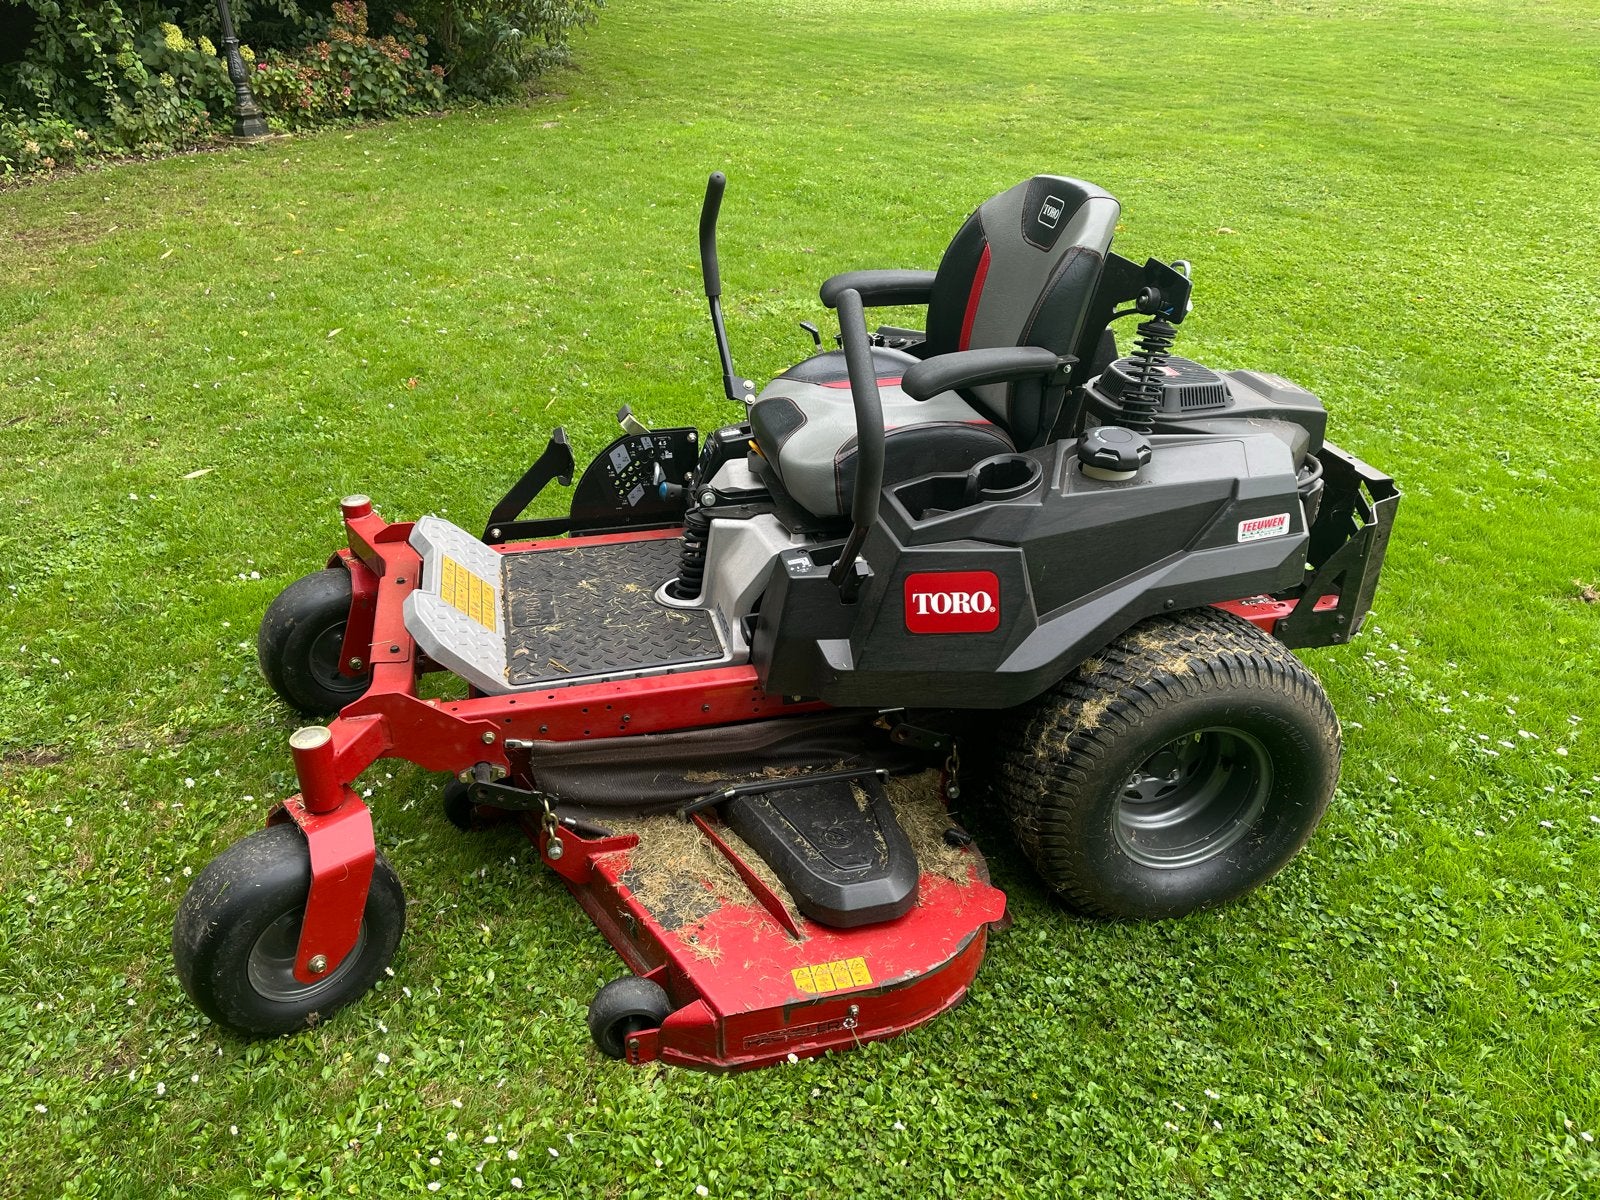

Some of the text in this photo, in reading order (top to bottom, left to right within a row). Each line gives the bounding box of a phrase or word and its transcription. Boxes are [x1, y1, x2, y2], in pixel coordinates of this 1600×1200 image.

[1043, 204, 1059, 219] TORO
[1242, 516, 1286, 532] TEEUWEN
[912, 591, 992, 615] TORO
